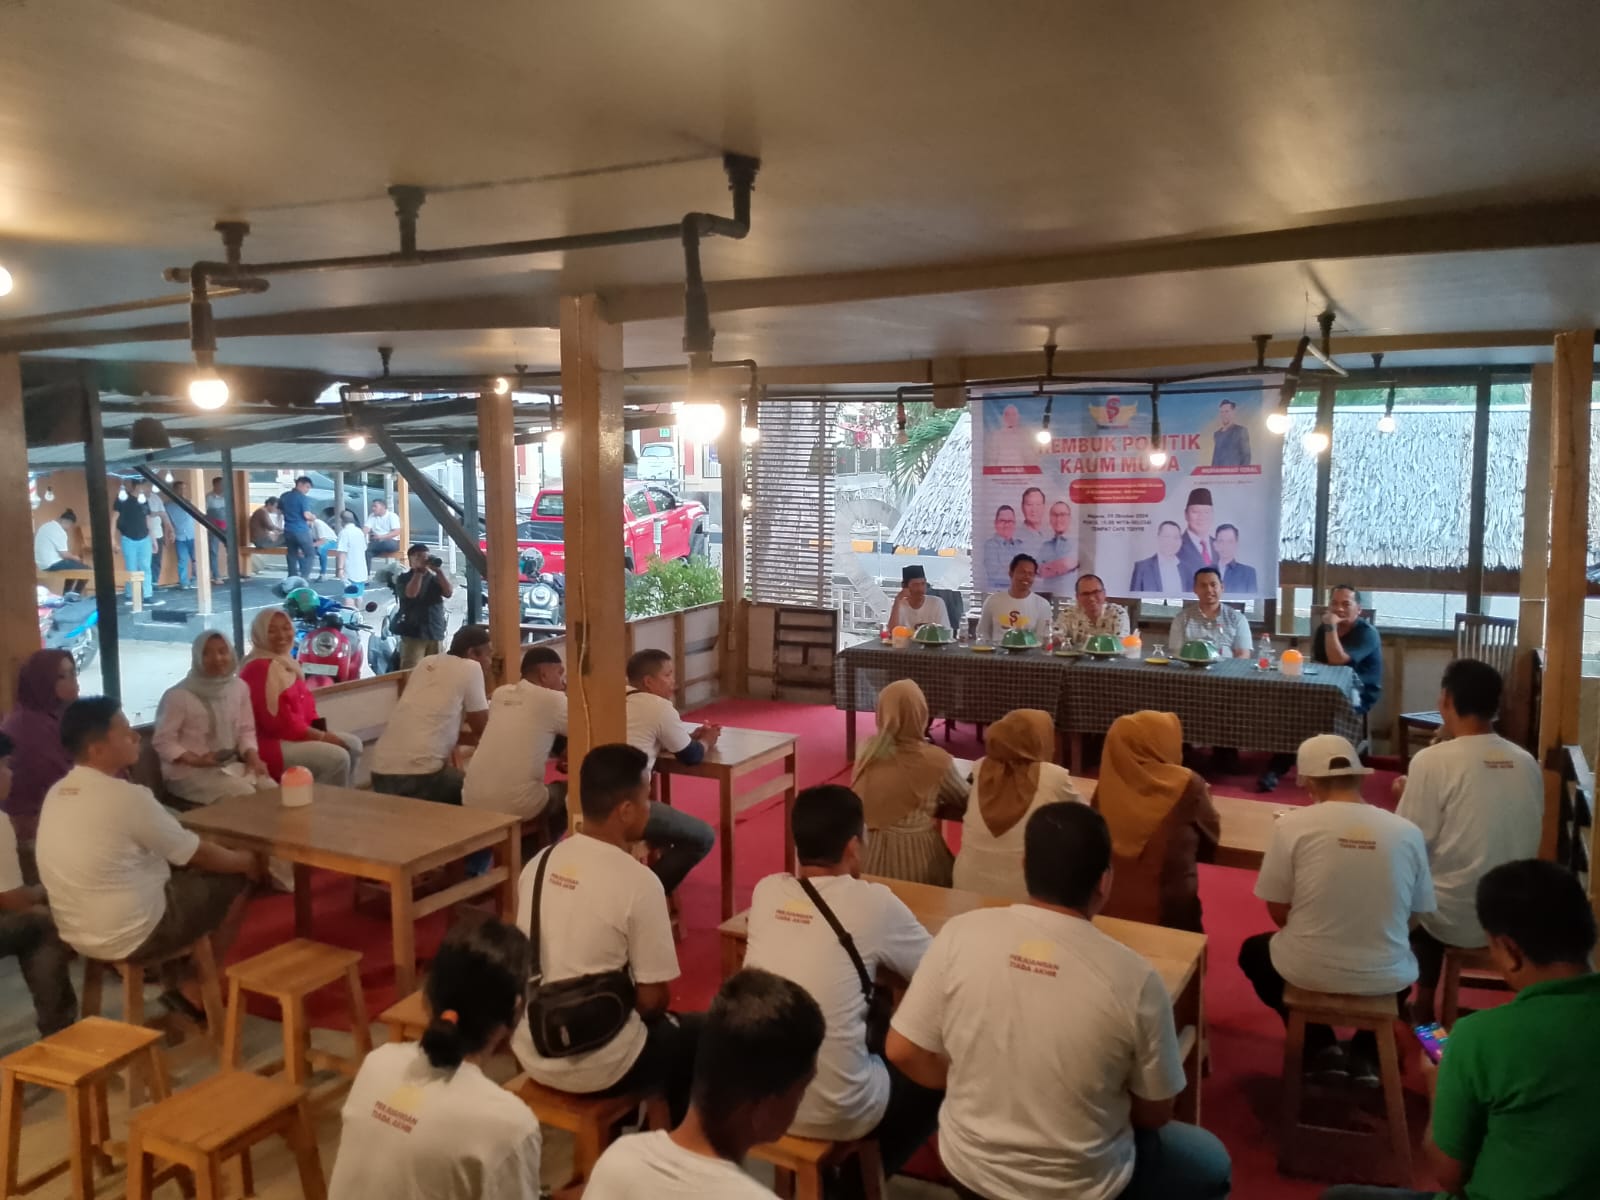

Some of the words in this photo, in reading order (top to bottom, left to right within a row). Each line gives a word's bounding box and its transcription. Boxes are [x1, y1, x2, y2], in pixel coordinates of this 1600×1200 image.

[1122, 434, 1201, 451] POITIK
[1060, 457, 1116, 473] KAUM
[1121, 455, 1180, 472] MUA
